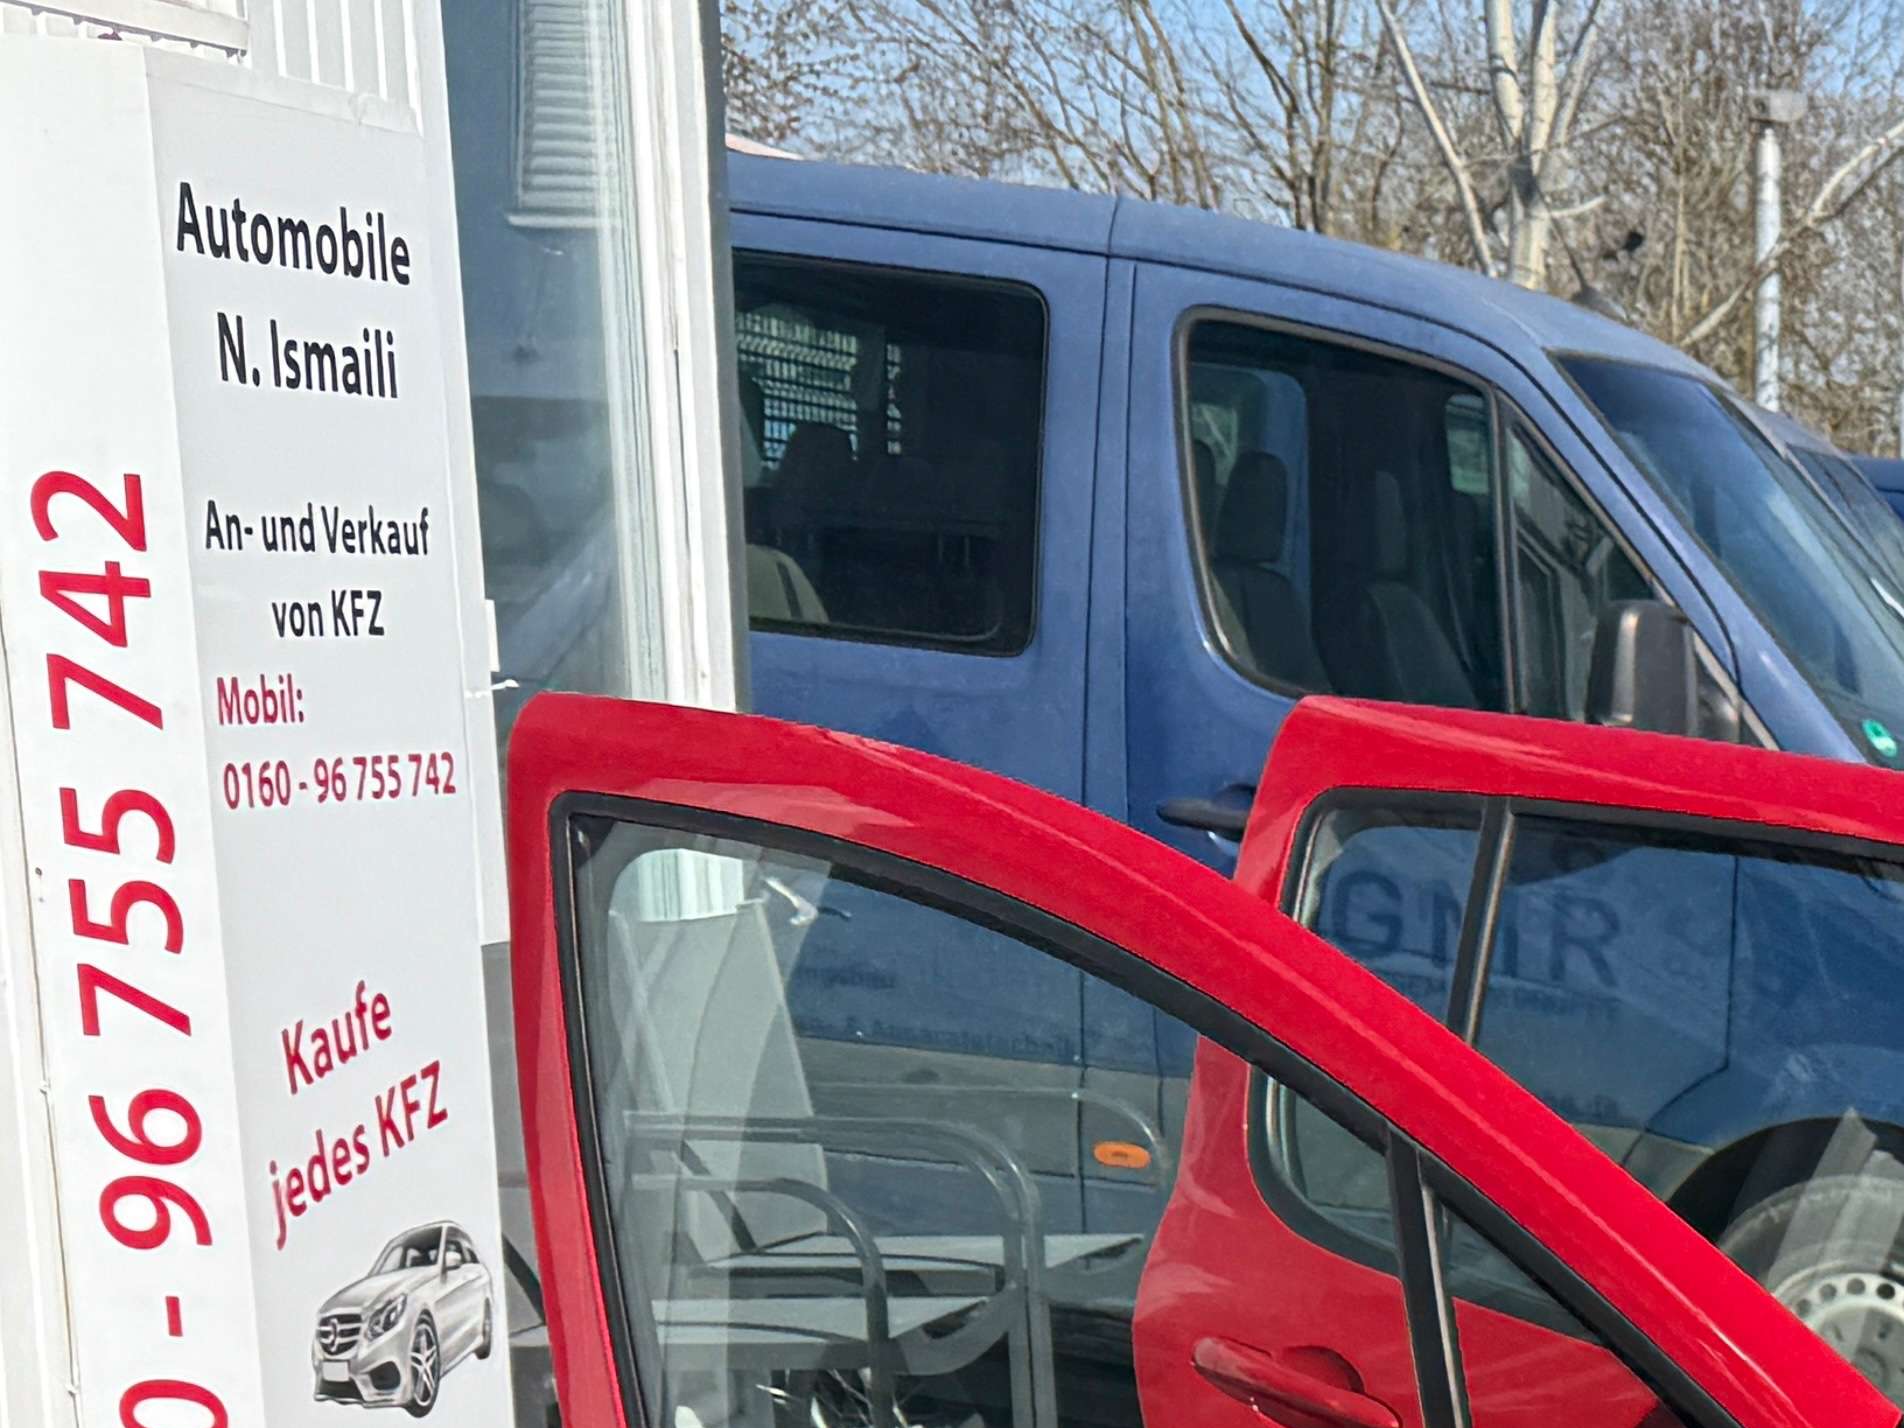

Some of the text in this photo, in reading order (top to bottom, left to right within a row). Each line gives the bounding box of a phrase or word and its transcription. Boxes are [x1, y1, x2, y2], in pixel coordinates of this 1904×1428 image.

[177, 181, 410, 285] Automobile
[217, 311, 398, 399] N. Ismaili
[206, 499, 428, 555] An- und Verkauf
[30, 470, 163, 730] 742
[271, 589, 385, 638] von KFZ
[216, 673, 304, 726] Mobil:
[223, 760, 292, 810] 0160
[314, 757, 347, 804] 96
[352, 754, 400, 801] 755
[408, 751, 456, 798] 742
[59, 787, 192, 1037] 755
[281, 979, 392, 1095] Kaufe
[88, 1088, 212, 1250] 96
[269, 1059, 448, 1251] jedes KFZ
